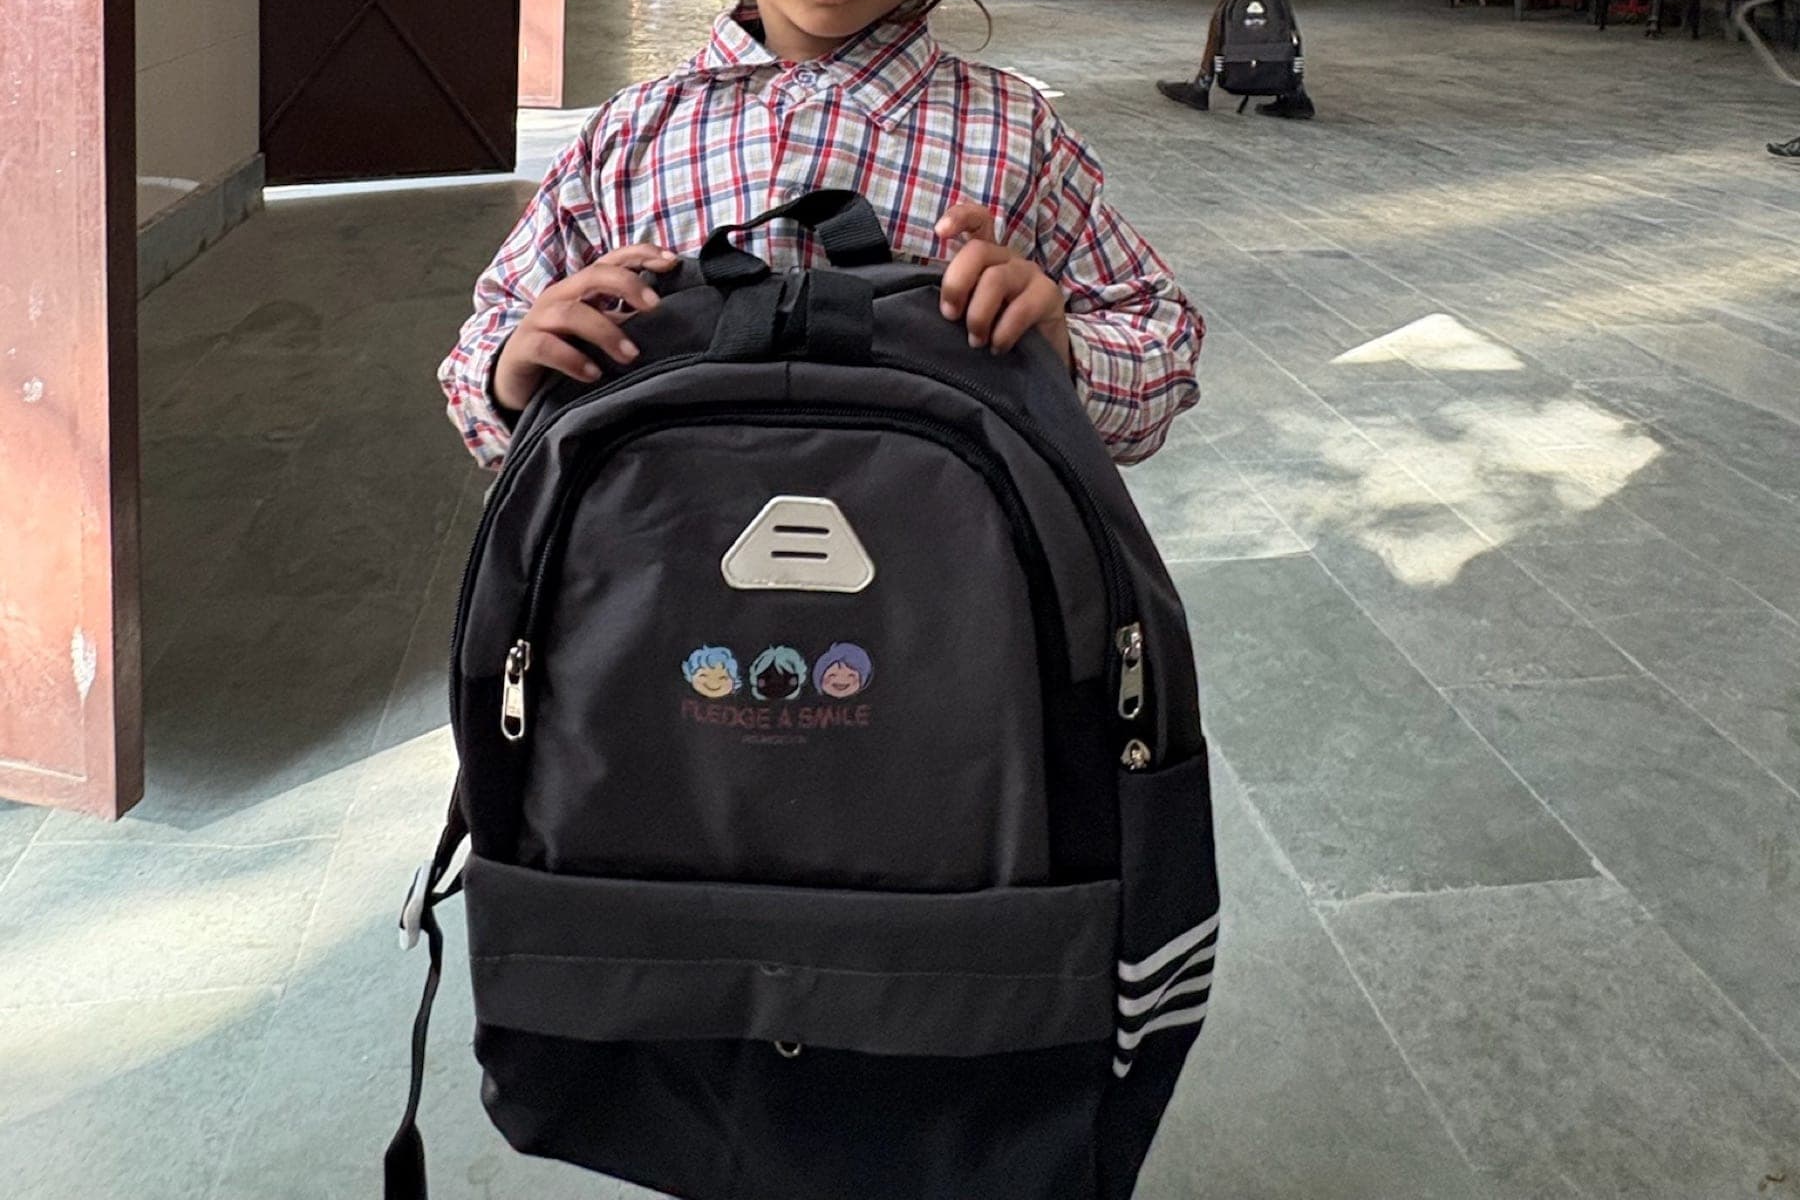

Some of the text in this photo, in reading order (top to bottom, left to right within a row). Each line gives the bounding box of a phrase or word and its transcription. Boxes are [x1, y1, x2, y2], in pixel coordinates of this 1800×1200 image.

[681, 700, 872, 729] PLEDGE A SMILE
